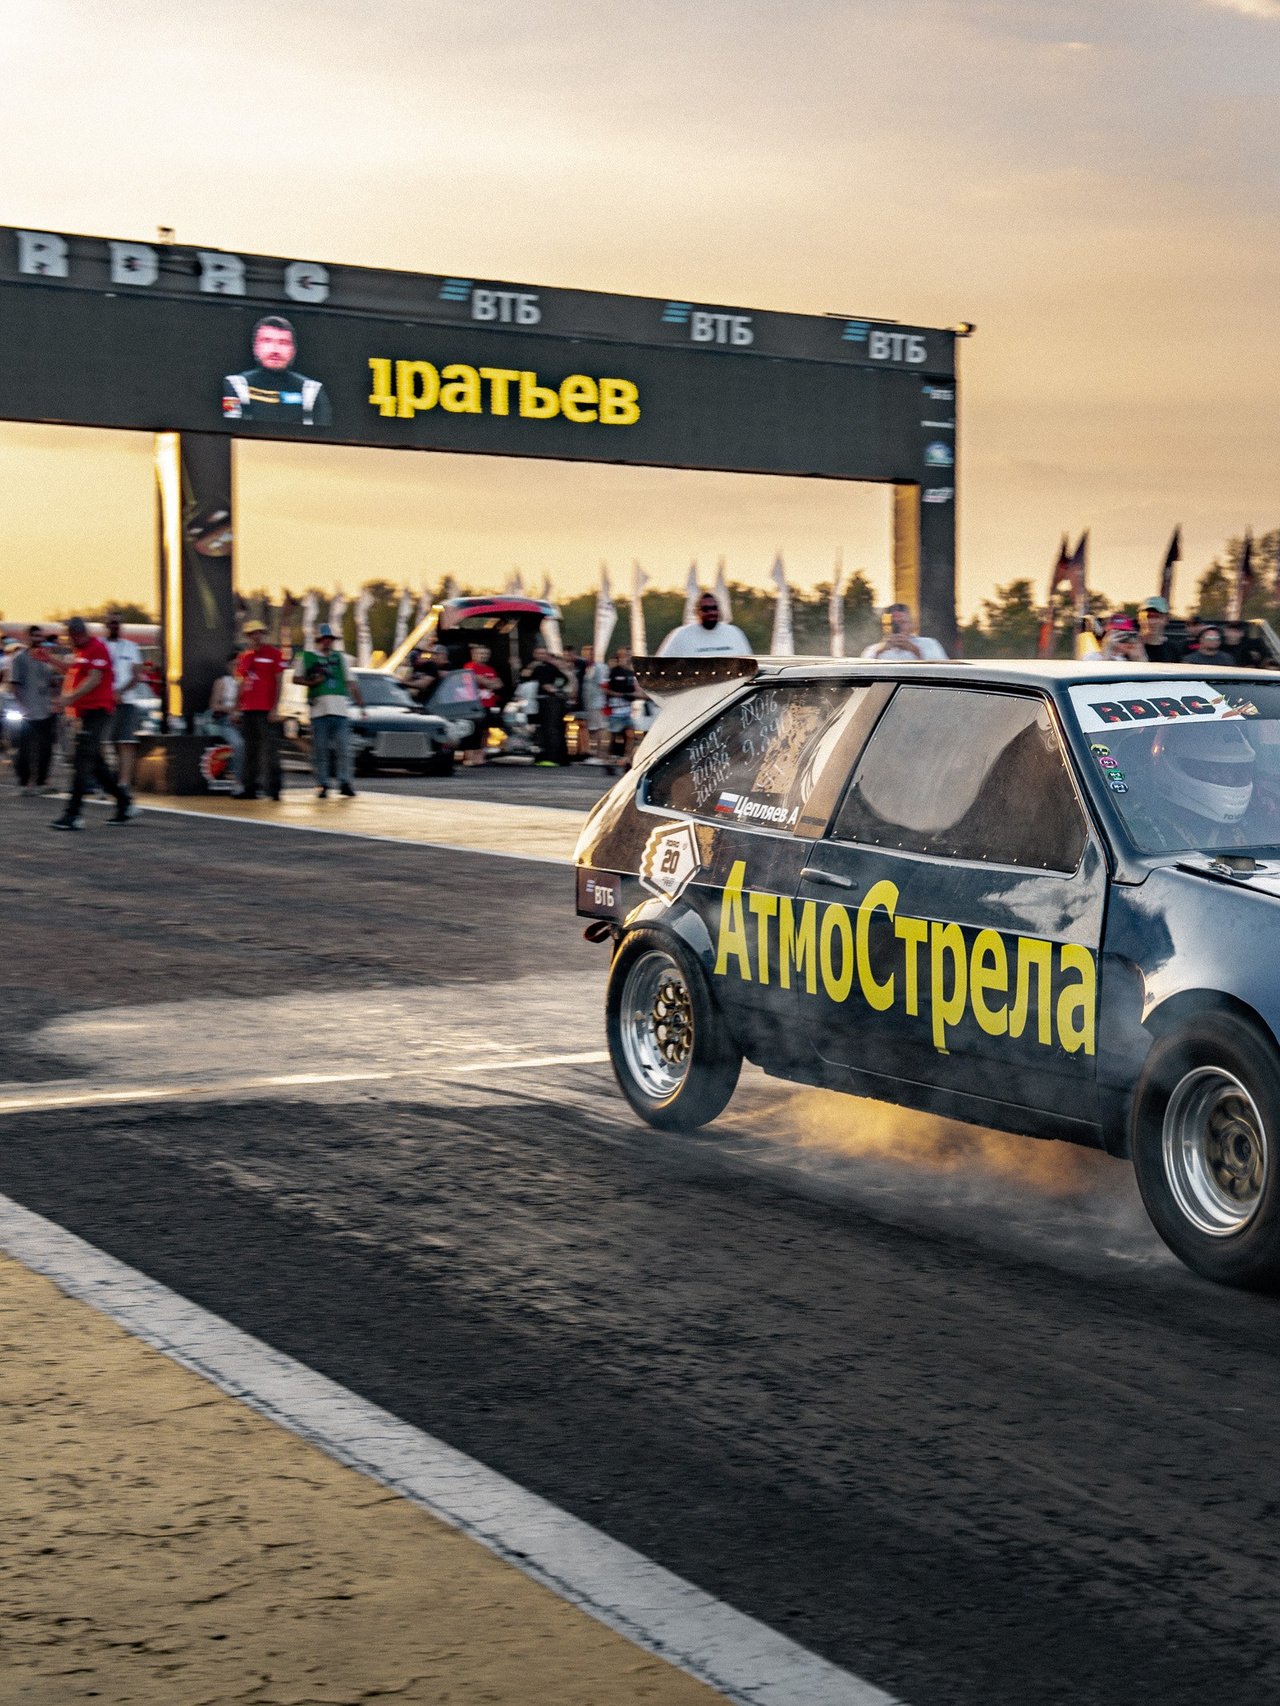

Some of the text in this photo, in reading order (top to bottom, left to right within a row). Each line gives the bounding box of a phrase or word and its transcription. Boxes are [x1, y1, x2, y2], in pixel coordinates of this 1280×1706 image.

[471, 289, 541, 325] ВТБ
[690, 311, 754, 346] ВТБ
[868, 330, 928, 364] ВТБ
[733, 795, 788, 823] Цепляев
[660, 848, 681, 875] 20
[594, 885, 615, 908] ВТБ
[714, 860, 1097, 1056] АтмоСтрела
